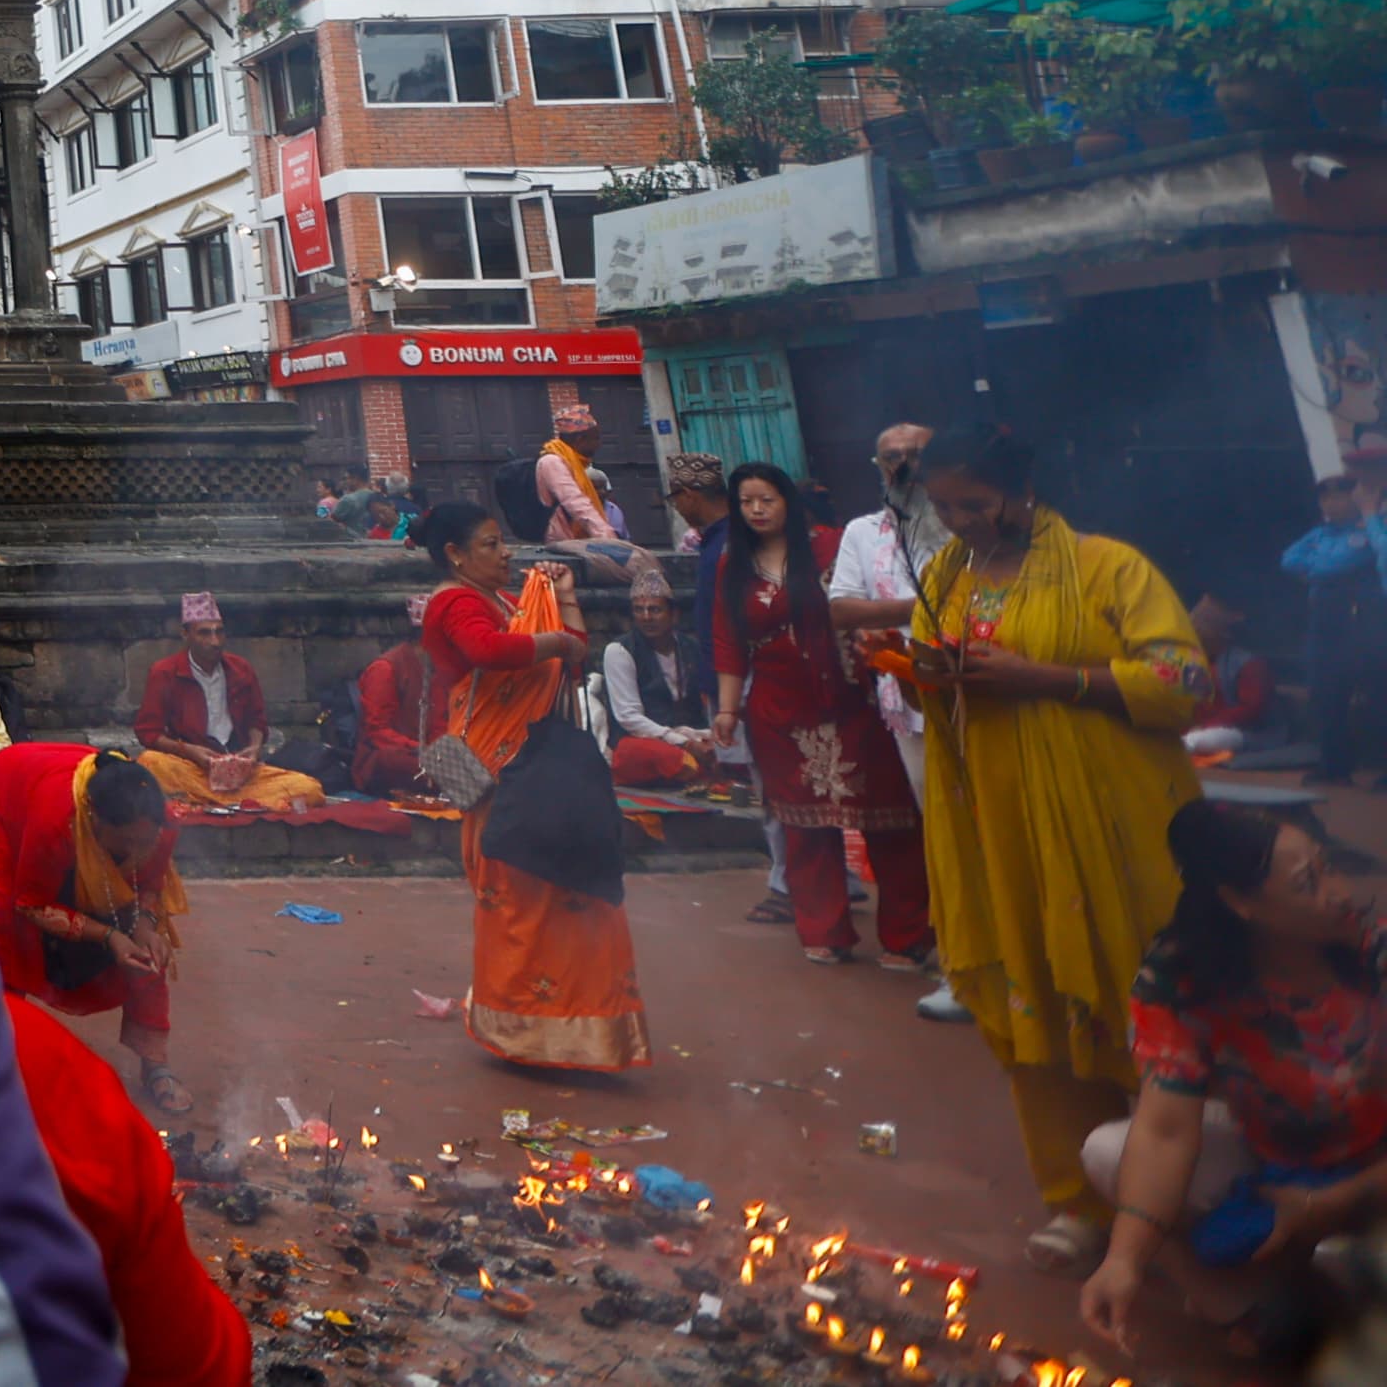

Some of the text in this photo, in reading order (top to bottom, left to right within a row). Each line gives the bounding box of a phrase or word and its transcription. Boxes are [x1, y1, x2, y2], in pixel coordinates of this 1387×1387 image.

[704, 188, 791, 223] HONACHA
[93, 337, 136, 357] Heranya
[429, 347, 558, 363] BONUM CHA
